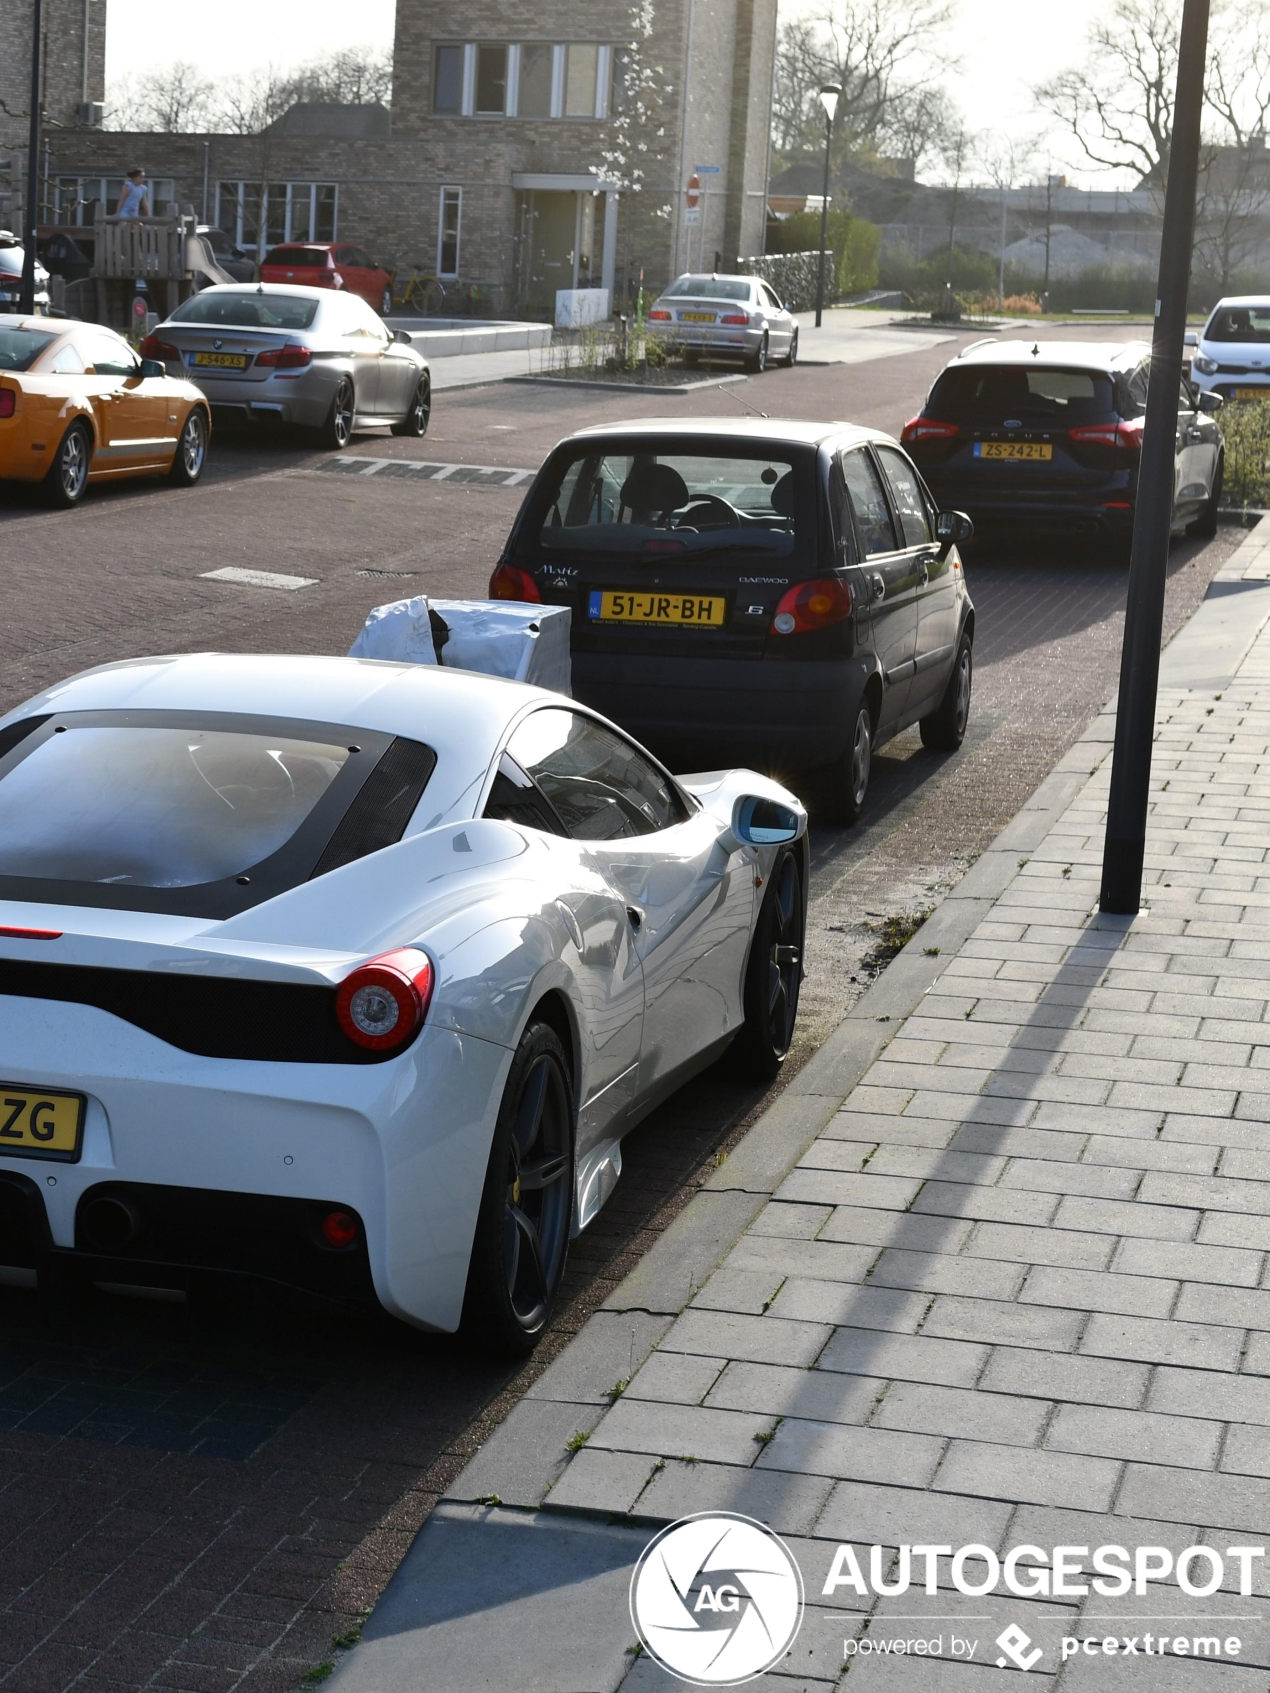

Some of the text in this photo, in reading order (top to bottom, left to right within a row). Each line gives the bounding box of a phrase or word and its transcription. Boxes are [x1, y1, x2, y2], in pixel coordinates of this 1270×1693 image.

[198, 353, 242, 366] J-546-XS
[985, 444, 1047, 458] ZS-242-L
[534, 564, 579, 576] Matiz
[739, 576, 789, 585] DAEWOO
[590, 607, 599, 615] NL
[611, 595, 713, 620] 51-JR-BH
